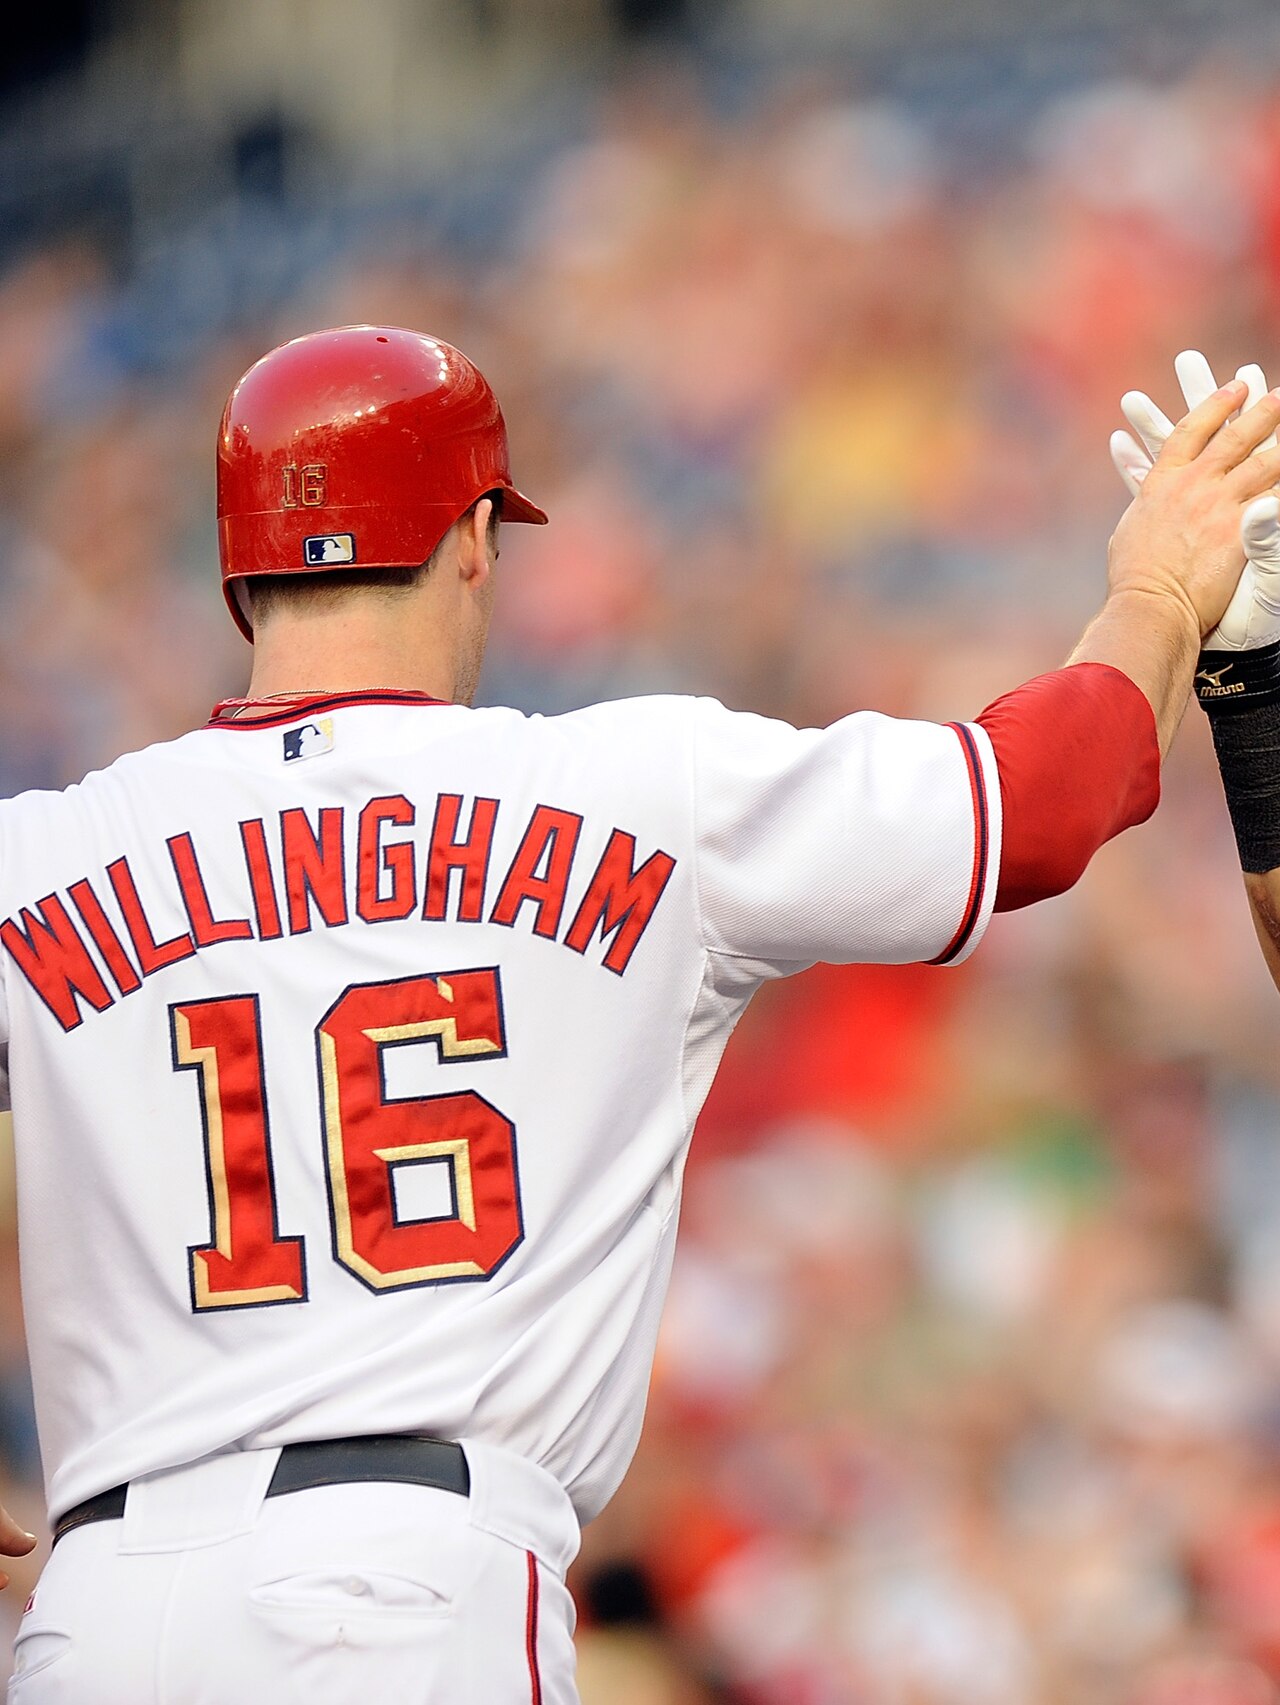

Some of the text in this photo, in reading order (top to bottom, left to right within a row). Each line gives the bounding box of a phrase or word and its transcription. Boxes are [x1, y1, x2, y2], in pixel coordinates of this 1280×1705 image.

[282, 463, 328, 508] 16
[0, 793, 677, 1033] WILLINGHAM
[168, 965, 525, 1313] 16
